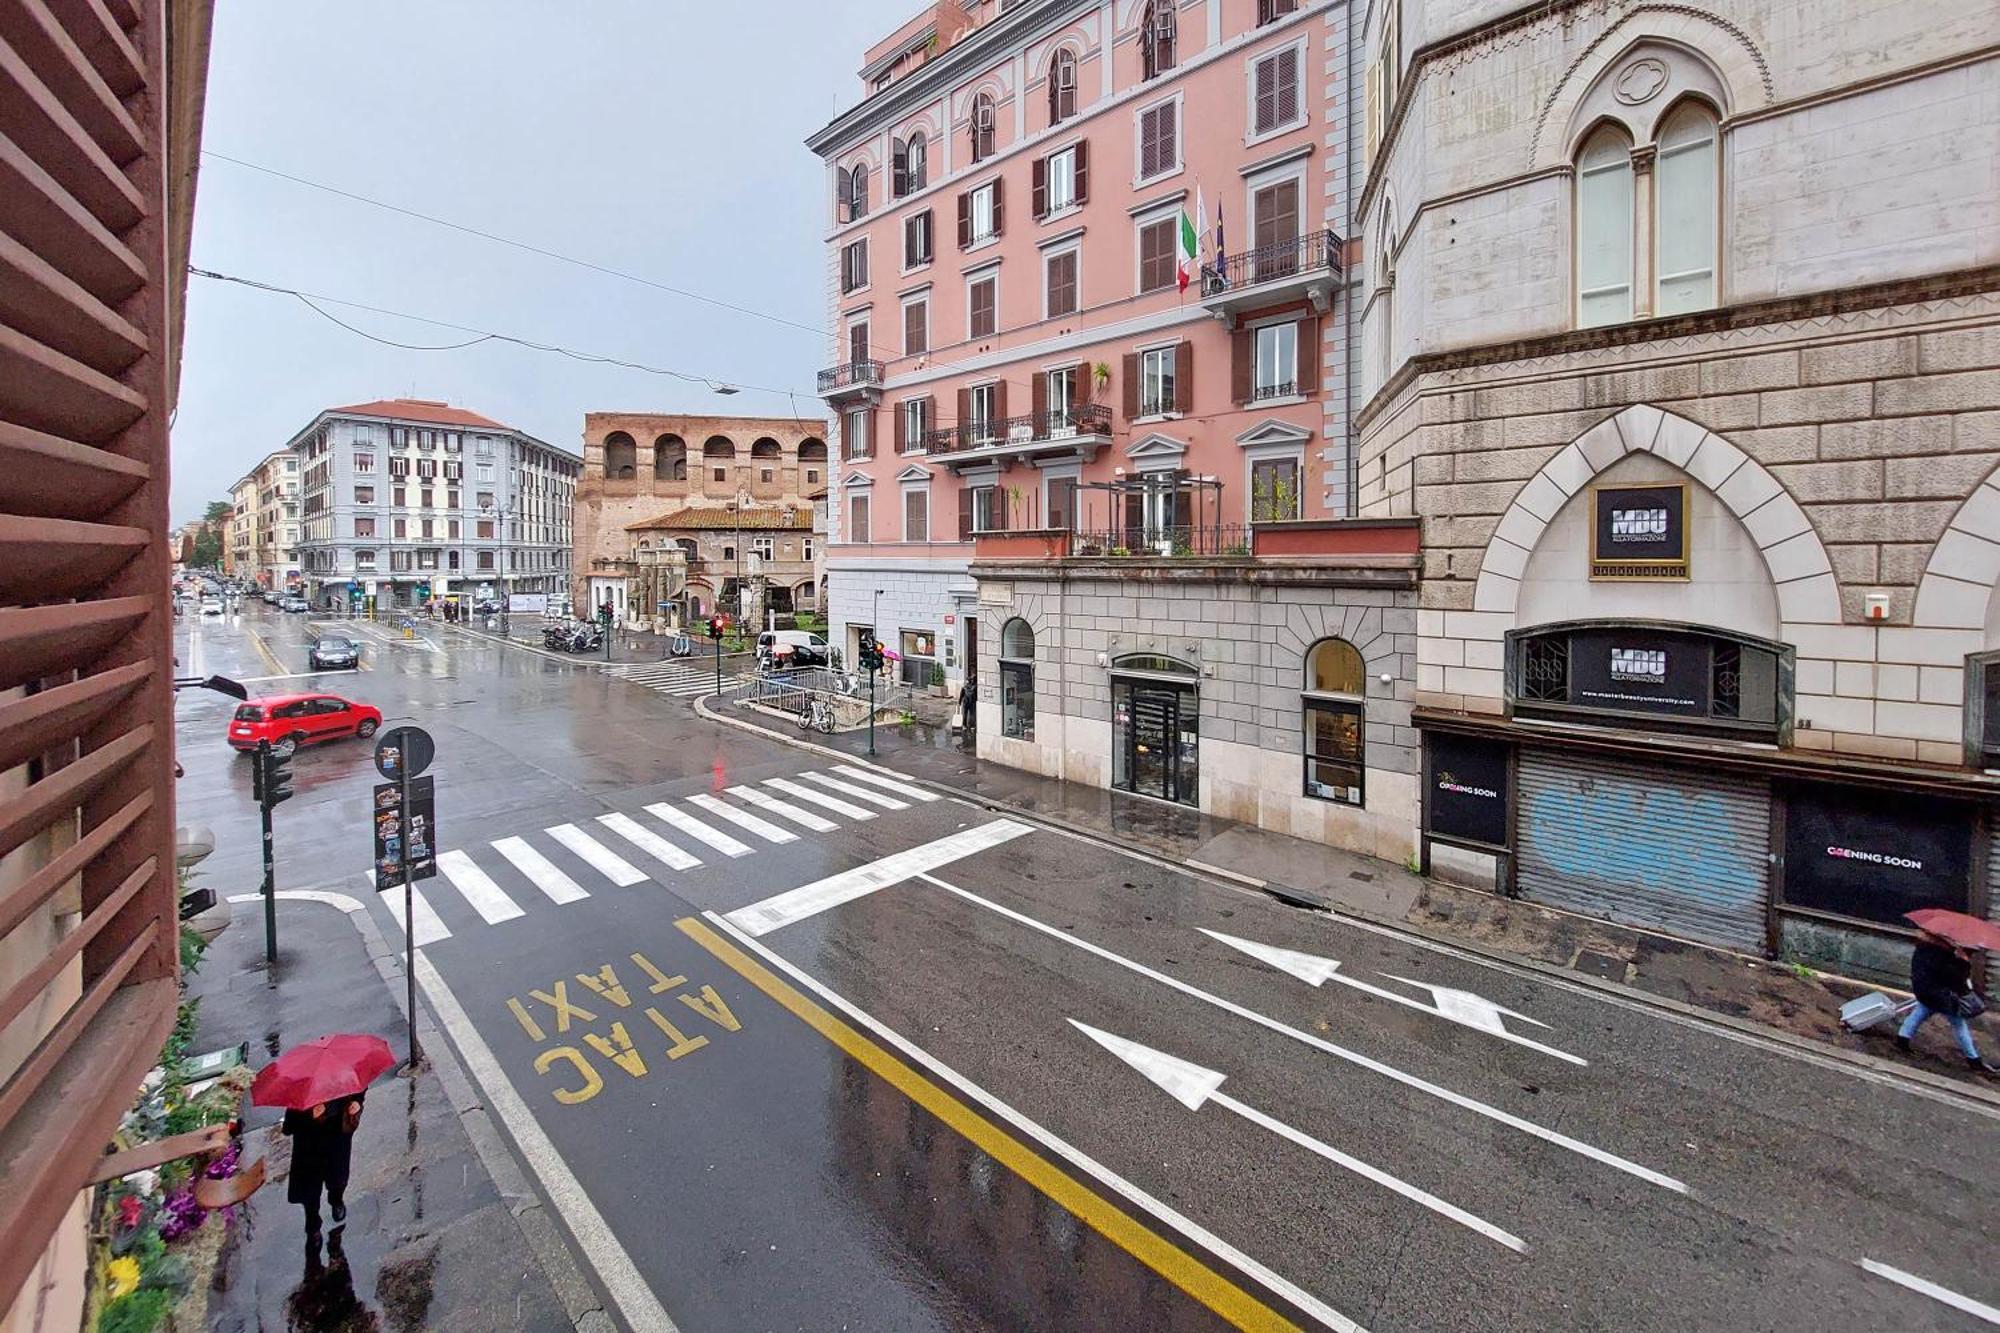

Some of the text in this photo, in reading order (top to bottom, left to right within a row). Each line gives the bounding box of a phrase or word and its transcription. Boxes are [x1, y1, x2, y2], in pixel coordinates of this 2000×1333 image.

[1473, 787, 1497, 797] SOON
[1883, 855, 1922, 870] SOON
[507, 952, 689, 1042] TAXI
[533, 985, 742, 1105] ATAC
